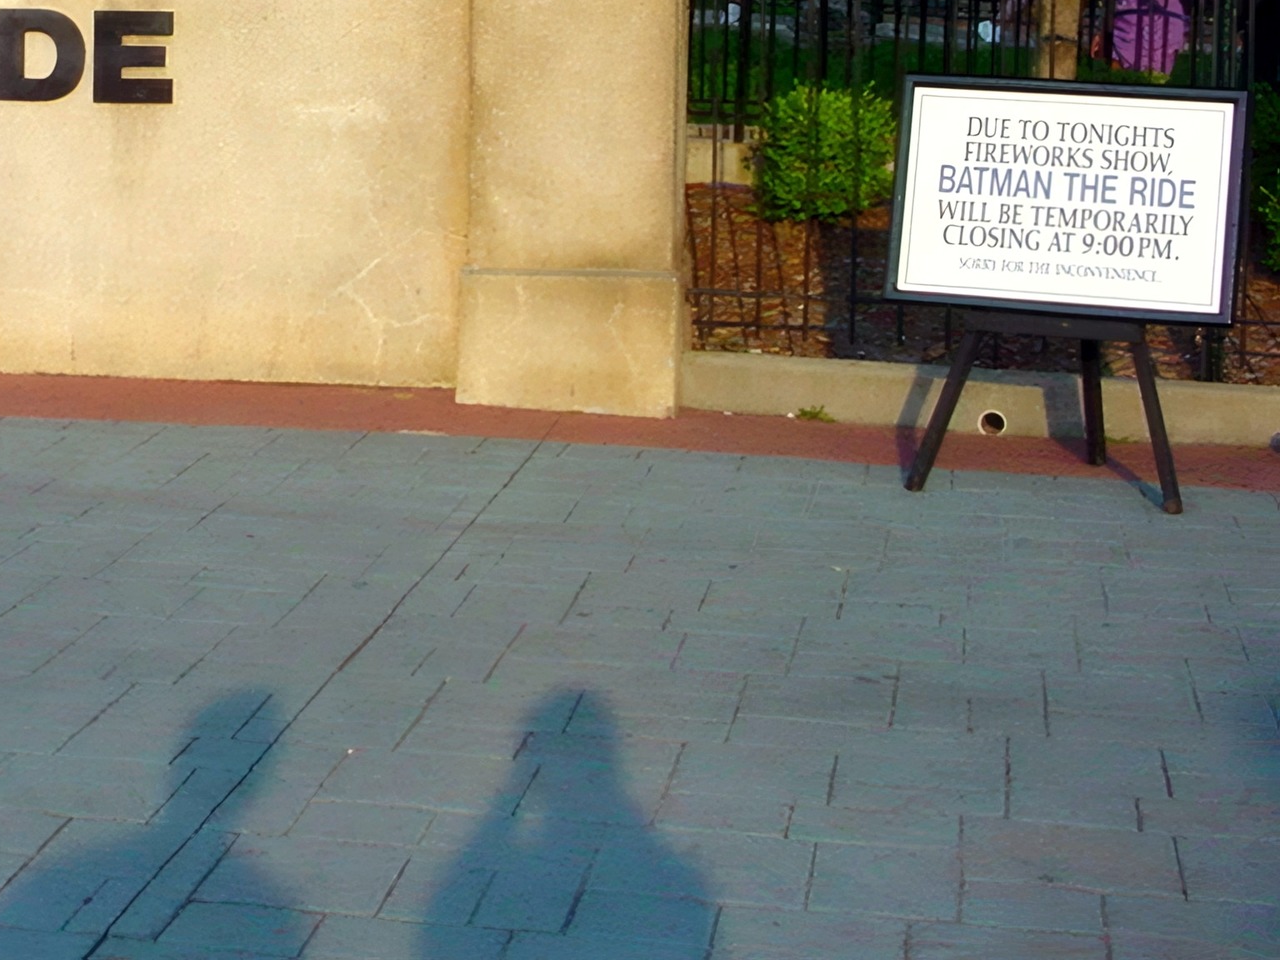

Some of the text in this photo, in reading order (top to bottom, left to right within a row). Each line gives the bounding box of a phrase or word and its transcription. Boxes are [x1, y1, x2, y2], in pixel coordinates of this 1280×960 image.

[967, 116, 1175, 149] DUE TO TONIGHTS
[964, 141, 1173, 176] FIREWORKS SHOW,
[938, 164, 1196, 209] BATMAN THE RIDE
[938, 199, 1194, 237] WILL BE TEMPORARILY
[942, 224, 1040, 252] CLOSING
[1047, 231, 1076, 254] AT
